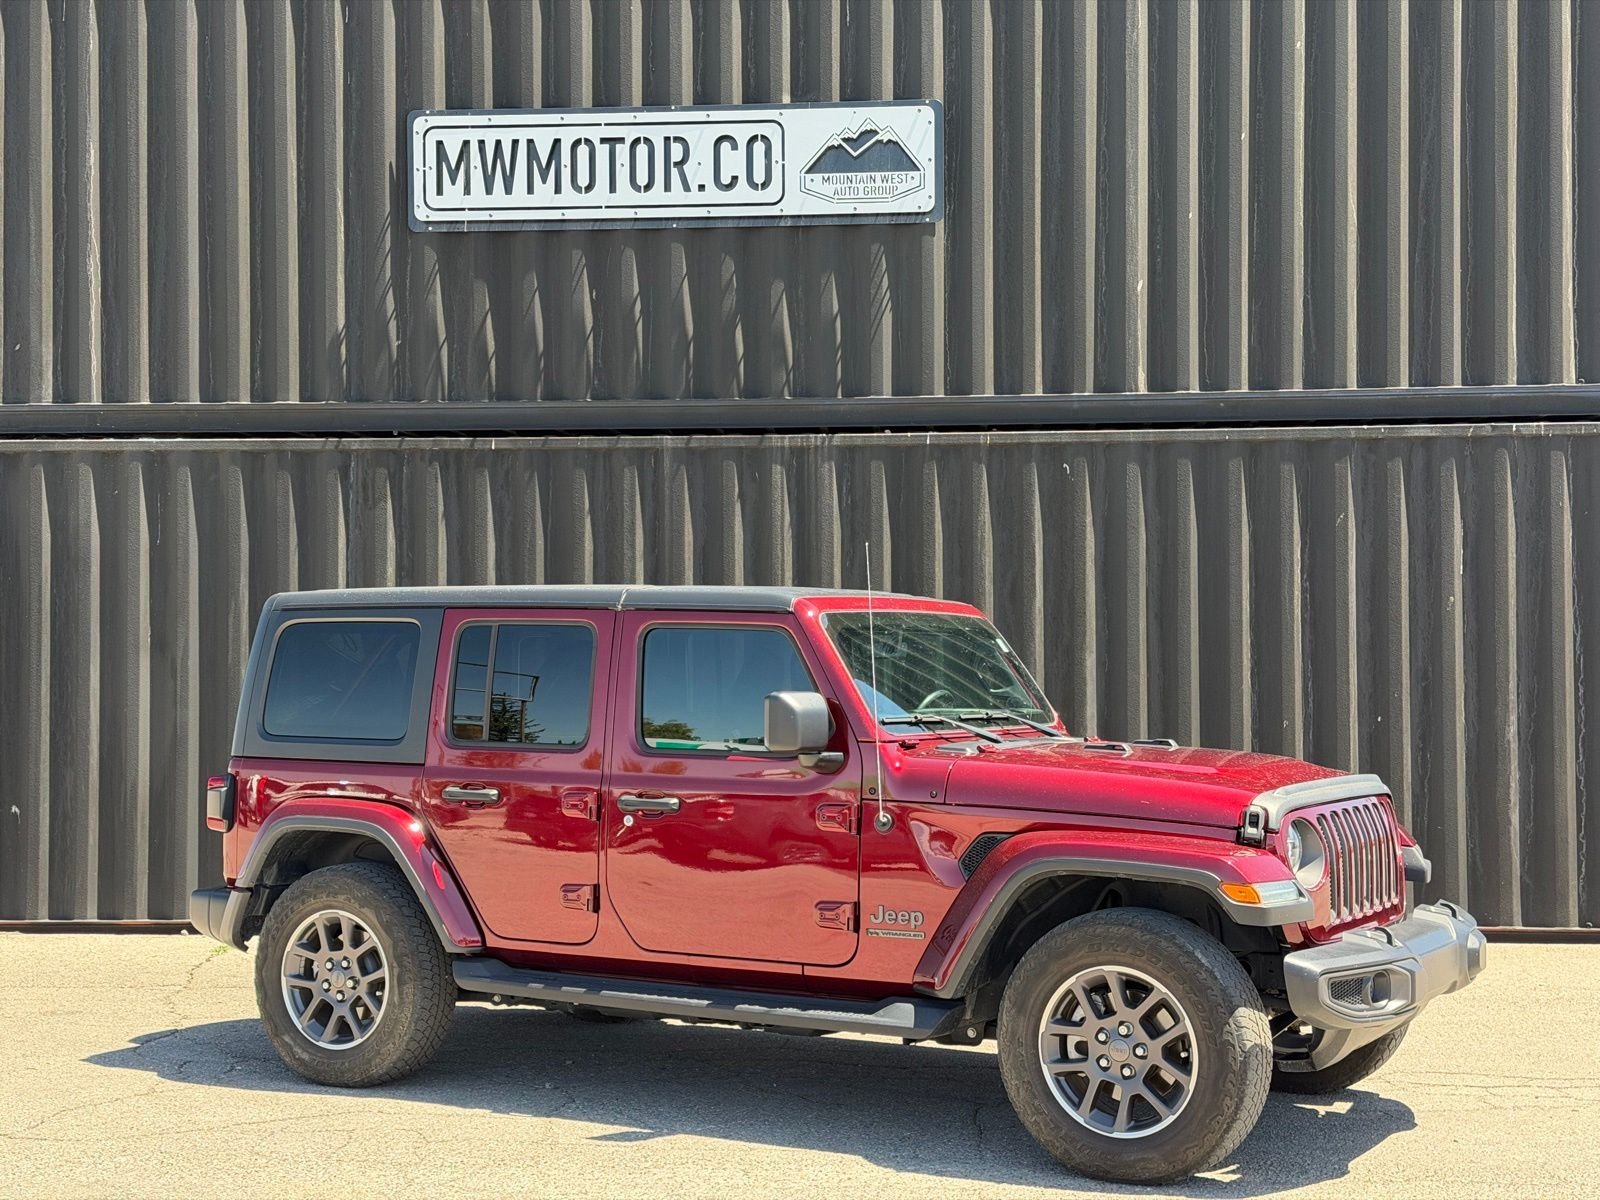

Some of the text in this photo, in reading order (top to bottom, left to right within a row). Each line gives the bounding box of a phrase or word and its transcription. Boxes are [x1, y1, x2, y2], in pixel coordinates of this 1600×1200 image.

[435, 134, 772, 196] MWMOTOR.CO
[821, 173, 909, 185] MOUNTAIN WEST
[833, 185, 898, 196] AUTO GROUP
[870, 904, 924, 928] Jeep
